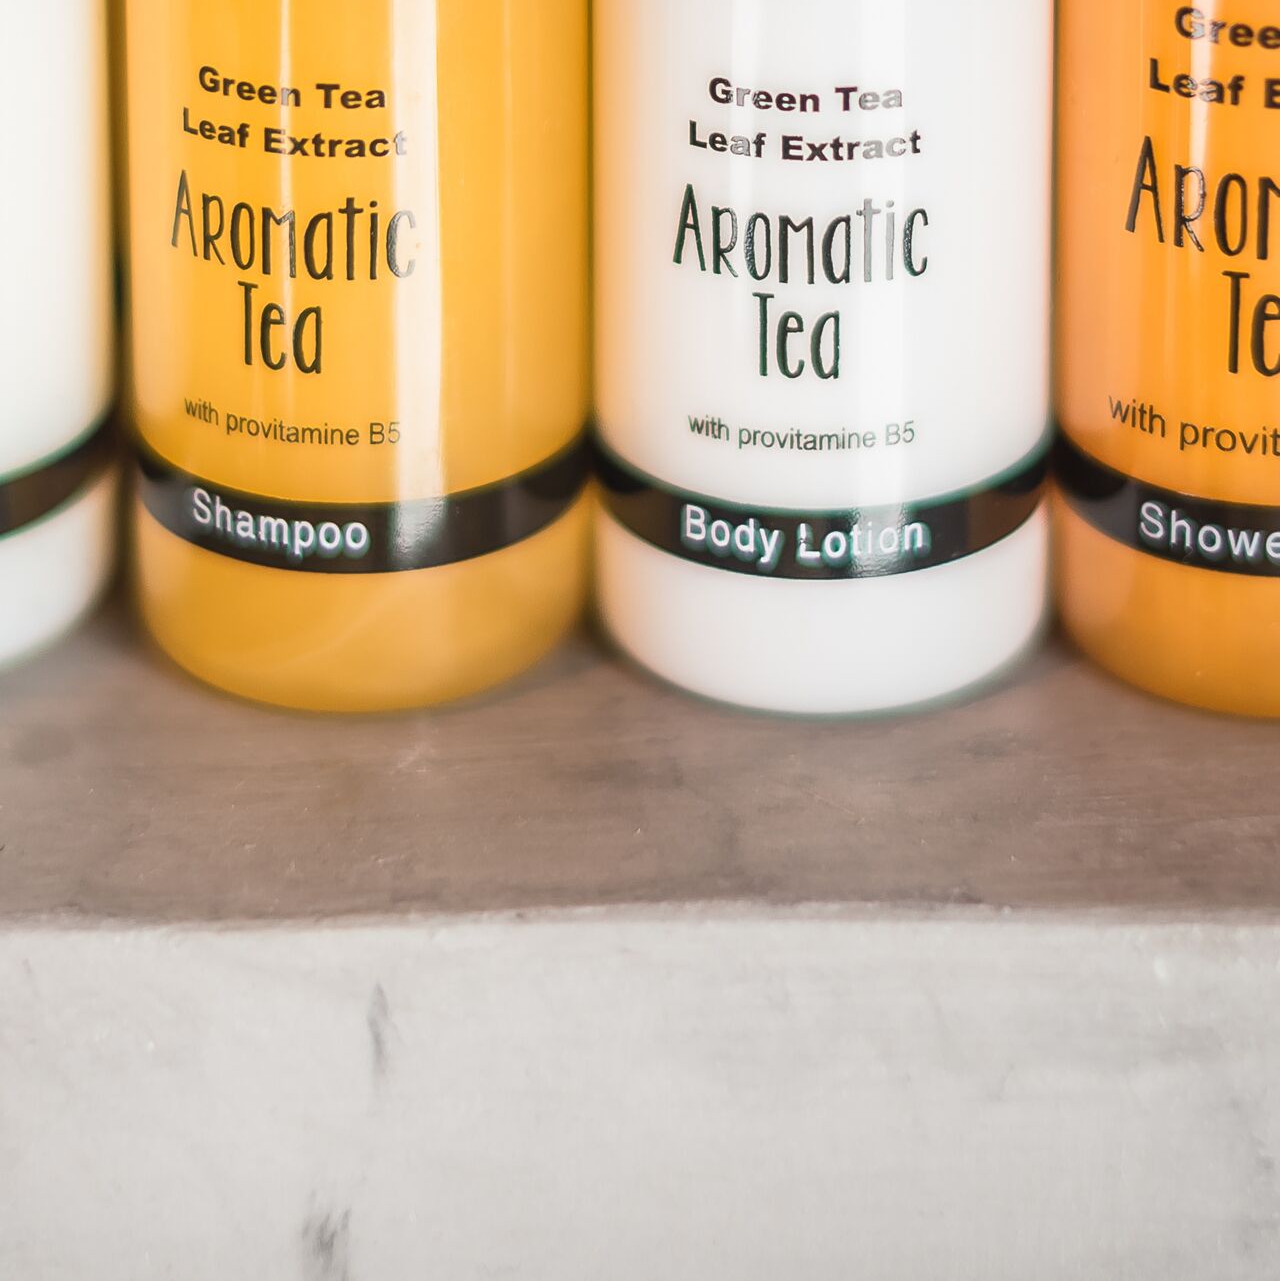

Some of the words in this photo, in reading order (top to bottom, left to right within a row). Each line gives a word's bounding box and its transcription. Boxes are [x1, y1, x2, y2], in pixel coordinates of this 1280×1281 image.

[198, 66, 302, 107] Green
[316, 83, 386, 109] Tea
[708, 77, 820, 113] Green
[835, 85, 904, 111] Tea
[1149, 57, 1244, 106] Leaf
[183, 107, 249, 148] Leaf
[264, 127, 408, 158] Extract
[688, 119, 766, 159] Leaf
[782, 130, 921, 161] Extract
[171, 169, 416, 281] Aromatic
[672, 183, 928, 284] Aromatic
[237, 280, 323, 374] Tea
[752, 292, 840, 379] Tea
[184, 397, 220, 426] with
[226, 411, 360, 447] provitamine
[369, 422, 401, 445] B5
[688, 414, 729, 441] with
[738, 422, 876, 451] provitamine
[885, 420, 916, 446] B5
[1109, 395, 1165, 438] with
[191, 489, 368, 556] Shampoo
[681, 504, 779, 563] Body
[798, 521, 924, 559] Lotion
